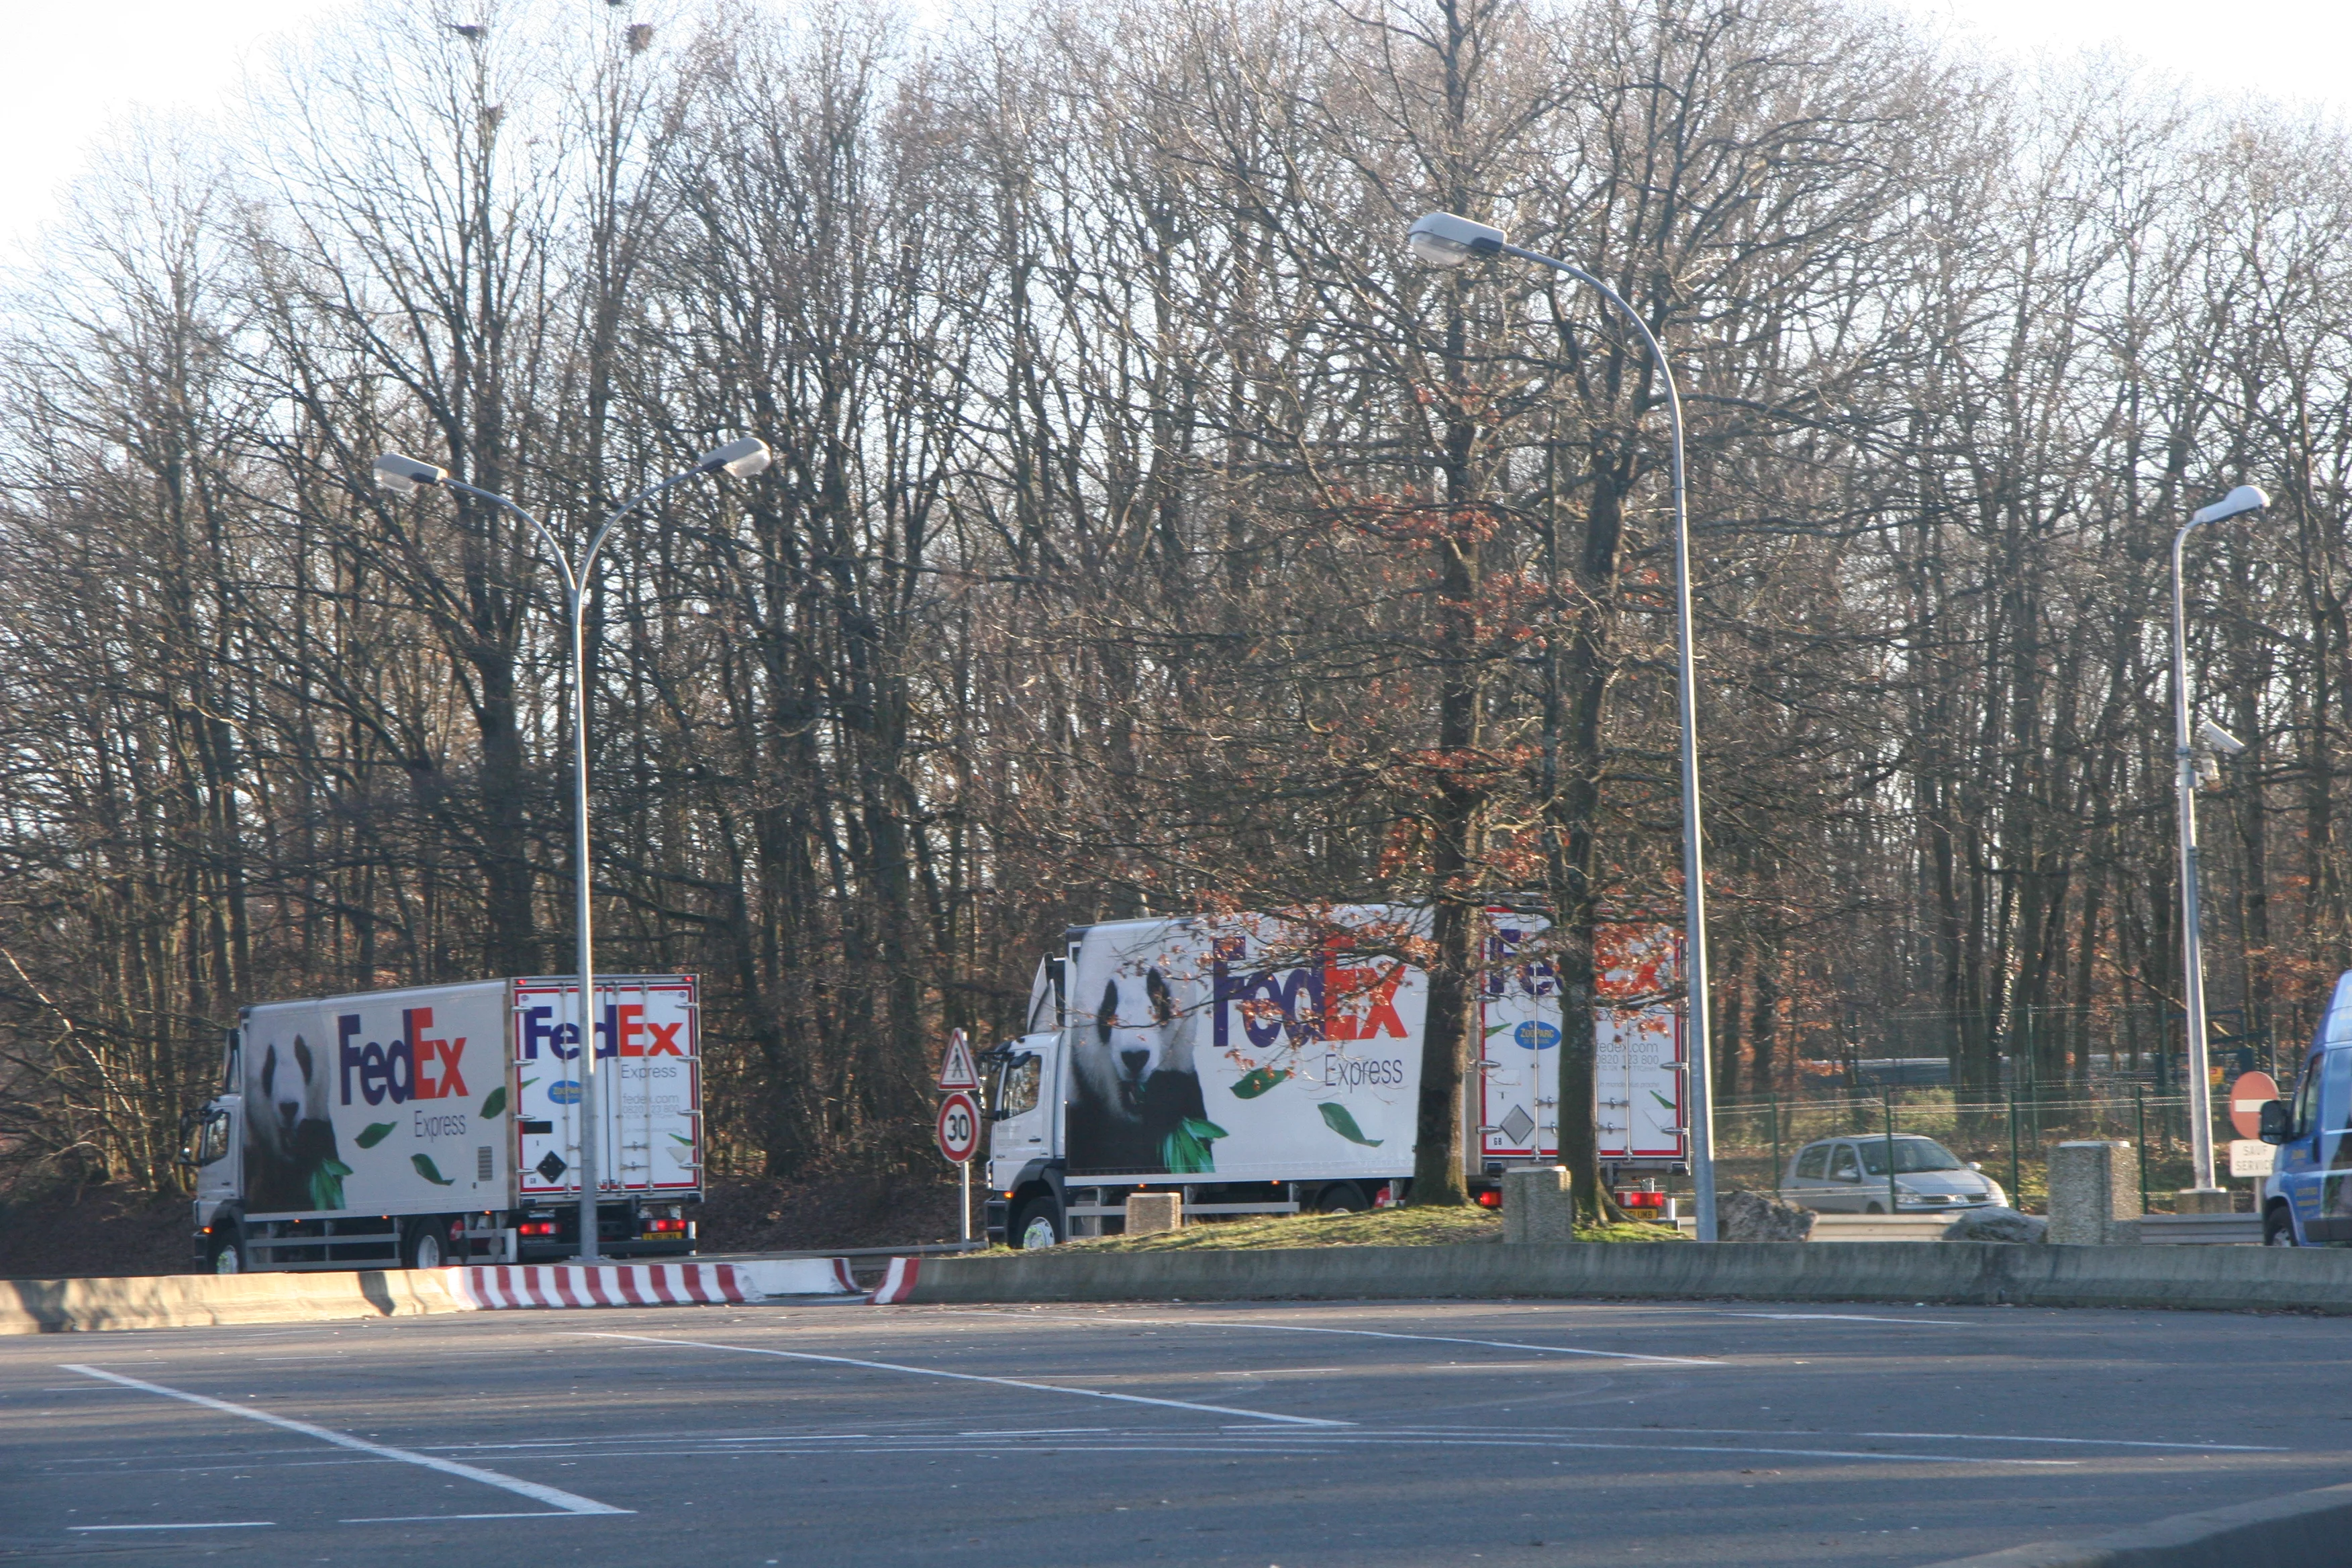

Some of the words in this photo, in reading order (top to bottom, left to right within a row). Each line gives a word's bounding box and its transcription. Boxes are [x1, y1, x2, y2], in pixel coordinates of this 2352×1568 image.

[1213, 934, 1408, 1048] FedEx
[524, 1004, 683, 1060] FedEx
[338, 1007, 469, 1106] FedEx
[621, 1064, 677, 1081] Express
[1325, 1054, 1403, 1093] Express
[414, 1110, 466, 1142] Express
[947, 1114, 969, 1141] 30
